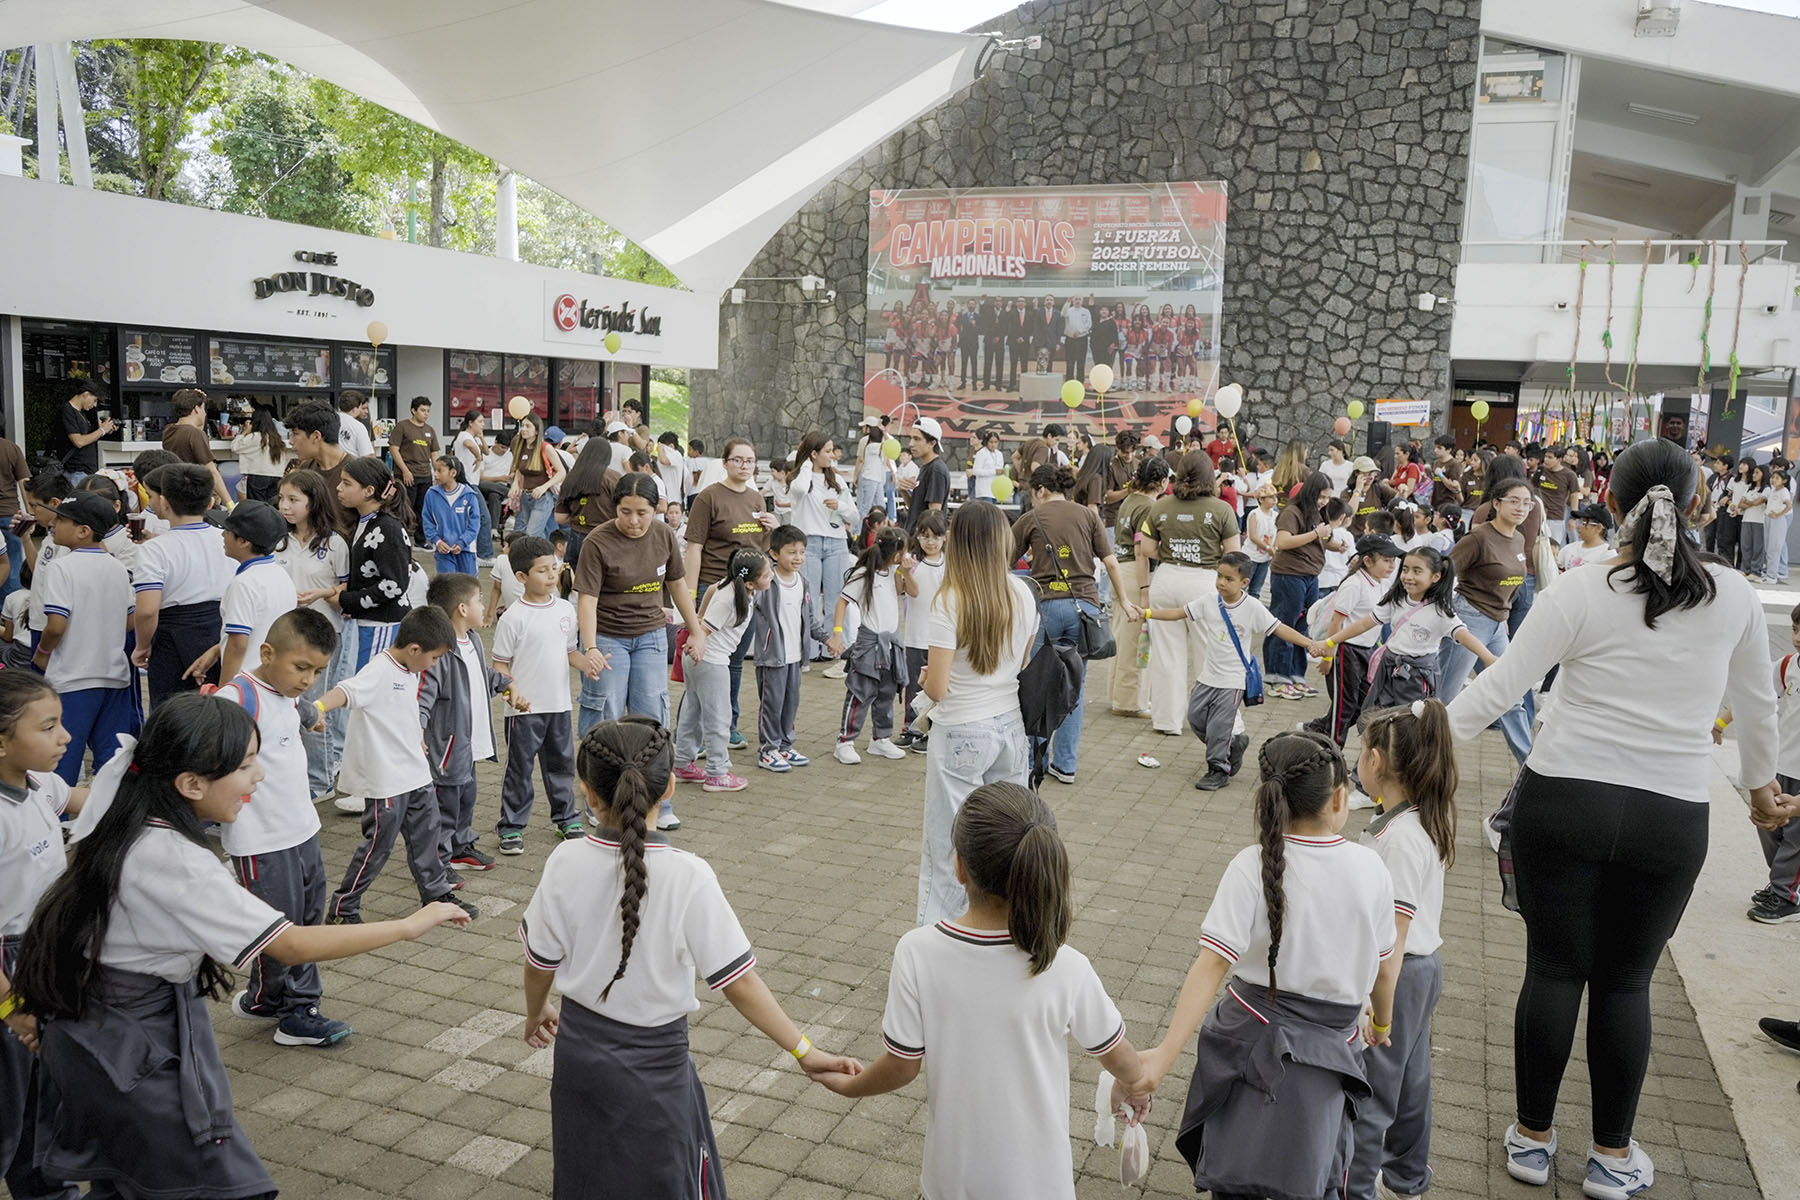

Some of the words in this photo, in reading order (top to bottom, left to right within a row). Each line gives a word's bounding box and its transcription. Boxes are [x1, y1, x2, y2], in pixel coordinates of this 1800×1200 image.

[889, 217, 1076, 267] CAMPEONAS
[1114, 229, 1181, 243] FUERZA
[1092, 246, 1131, 260] 2025
[1132, 242, 1201, 260] FÚTBOL
[930, 253, 1026, 279] NACIONALES
[1091, 261, 1138, 272] SOCCER
[1139, 261, 1191, 271] FEMENIL
[253, 271, 308, 299] DON
[309, 272, 375, 307] JUSTO
